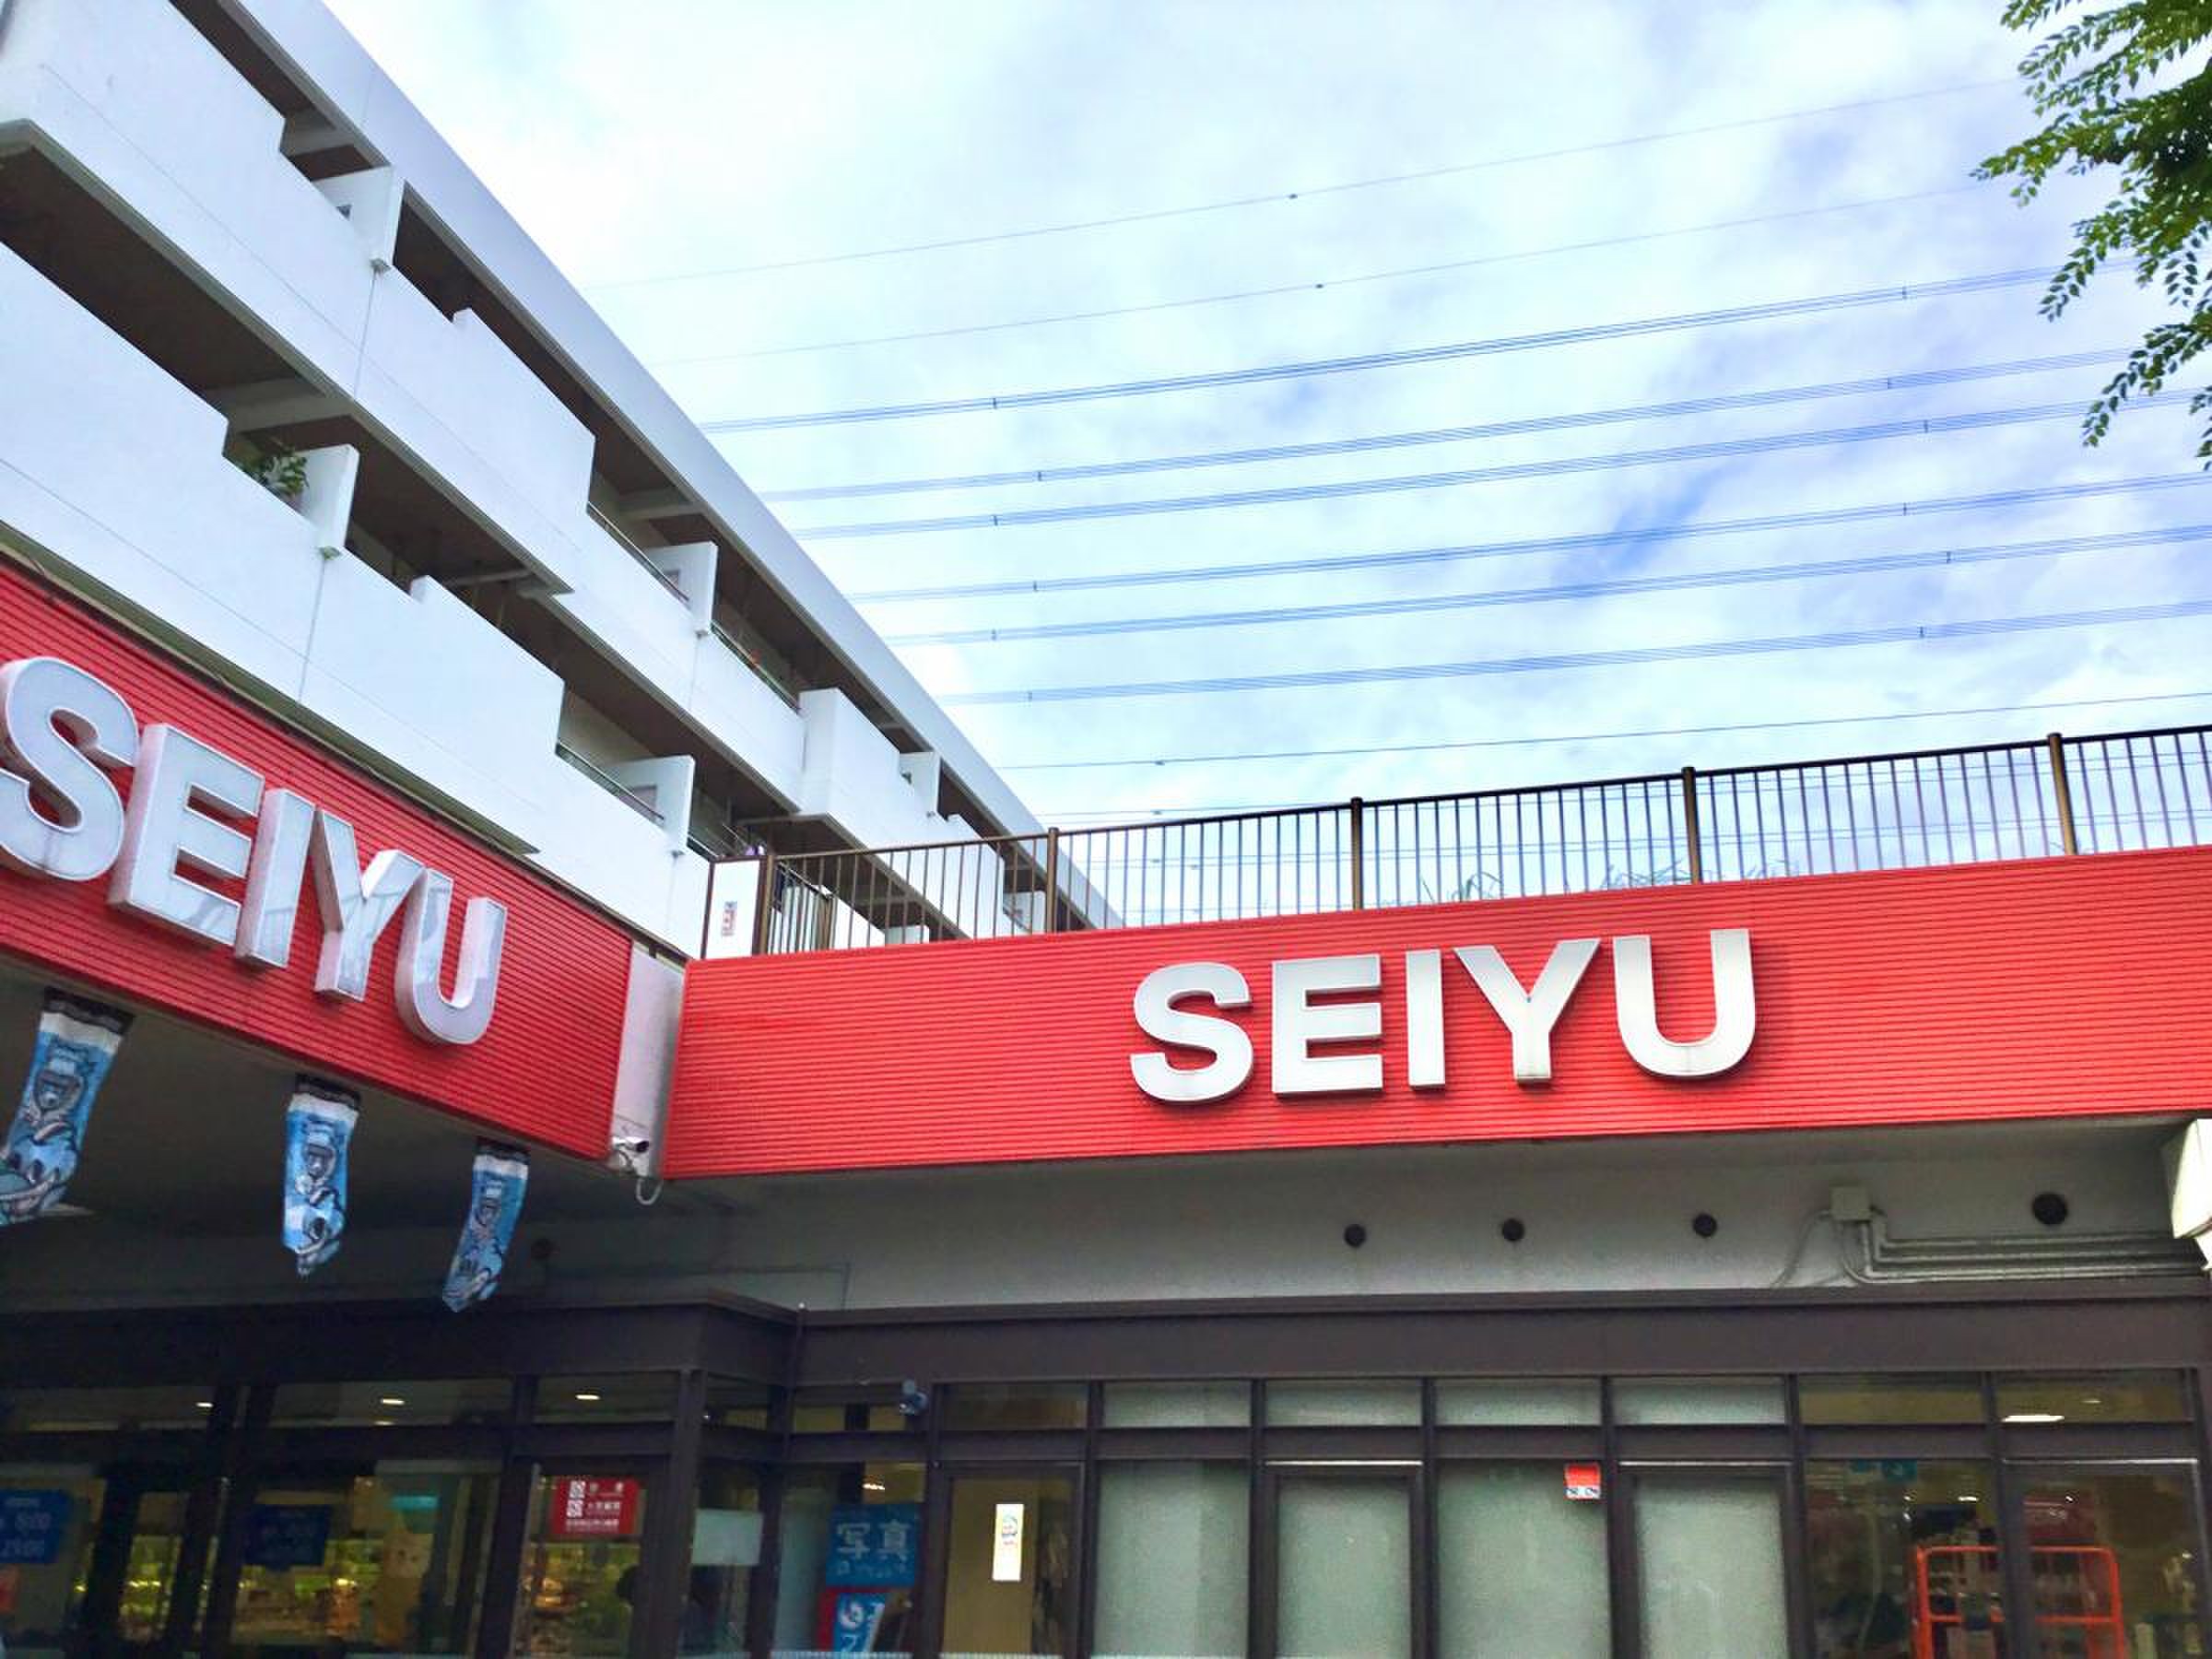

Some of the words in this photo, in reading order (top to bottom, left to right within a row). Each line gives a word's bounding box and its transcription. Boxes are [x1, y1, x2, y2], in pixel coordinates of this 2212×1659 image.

[0, 656, 508, 1044] SEIYU
[1130, 928, 1756, 1101] SEIYU
[836, 1519, 911, 1561] 写真
